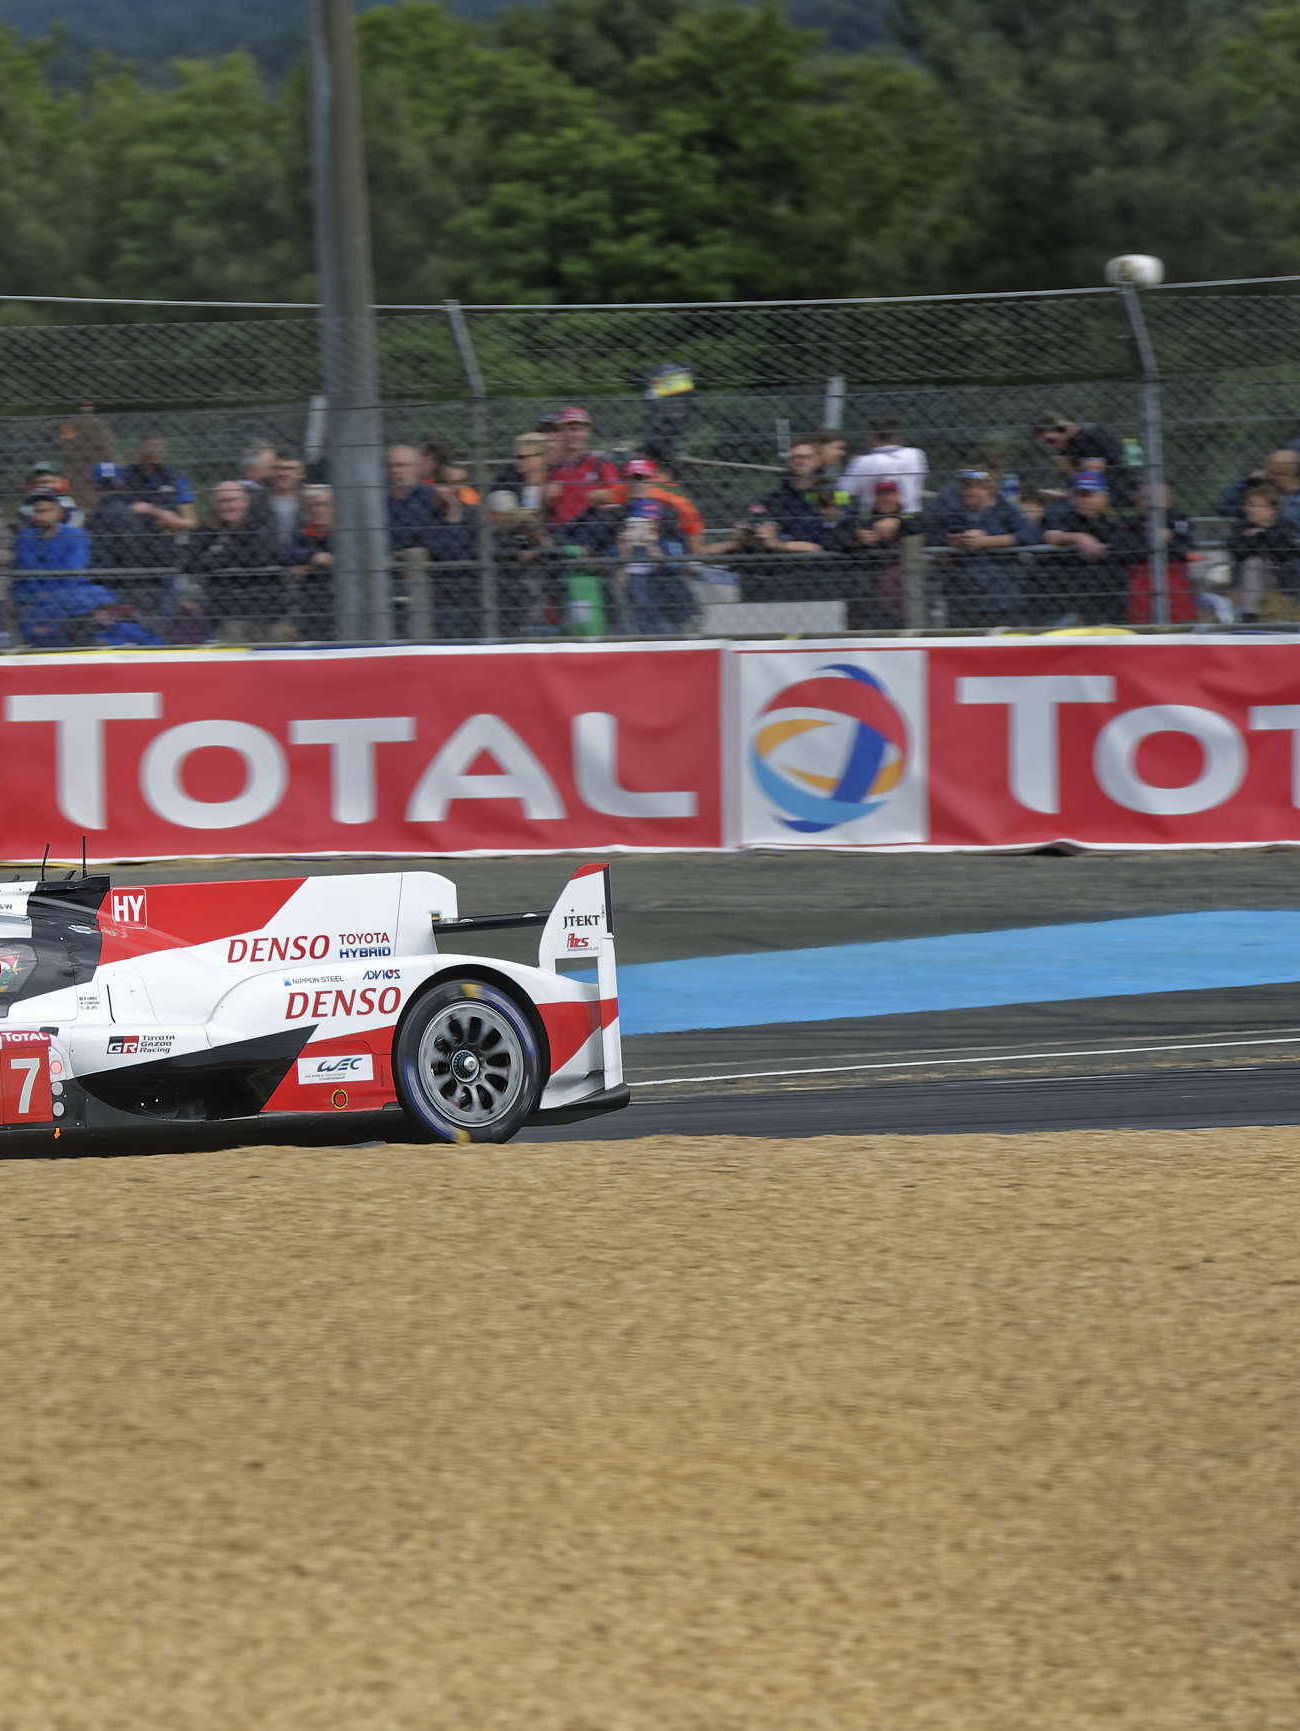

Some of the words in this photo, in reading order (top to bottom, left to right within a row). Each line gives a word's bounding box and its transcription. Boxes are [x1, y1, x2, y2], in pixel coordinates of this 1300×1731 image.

[6, 692, 696, 831] TOTAL
[113, 895, 144, 922] HY
[563, 915, 600, 929] JTEKT
[338, 932, 390, 945] TOYOTA
[227, 935, 330, 963] DENSO
[339, 946, 391, 958] HYBRID
[292, 977, 320, 985] NIPPON
[322, 975, 344, 983] STEEL
[285, 986, 401, 1020] DENSO
[2, 1032, 49, 1042] TOTAL
[107, 1042, 138, 1054] GR
[317, 1057, 363, 1072] WEC
[10, 1057, 40, 1114] 7
